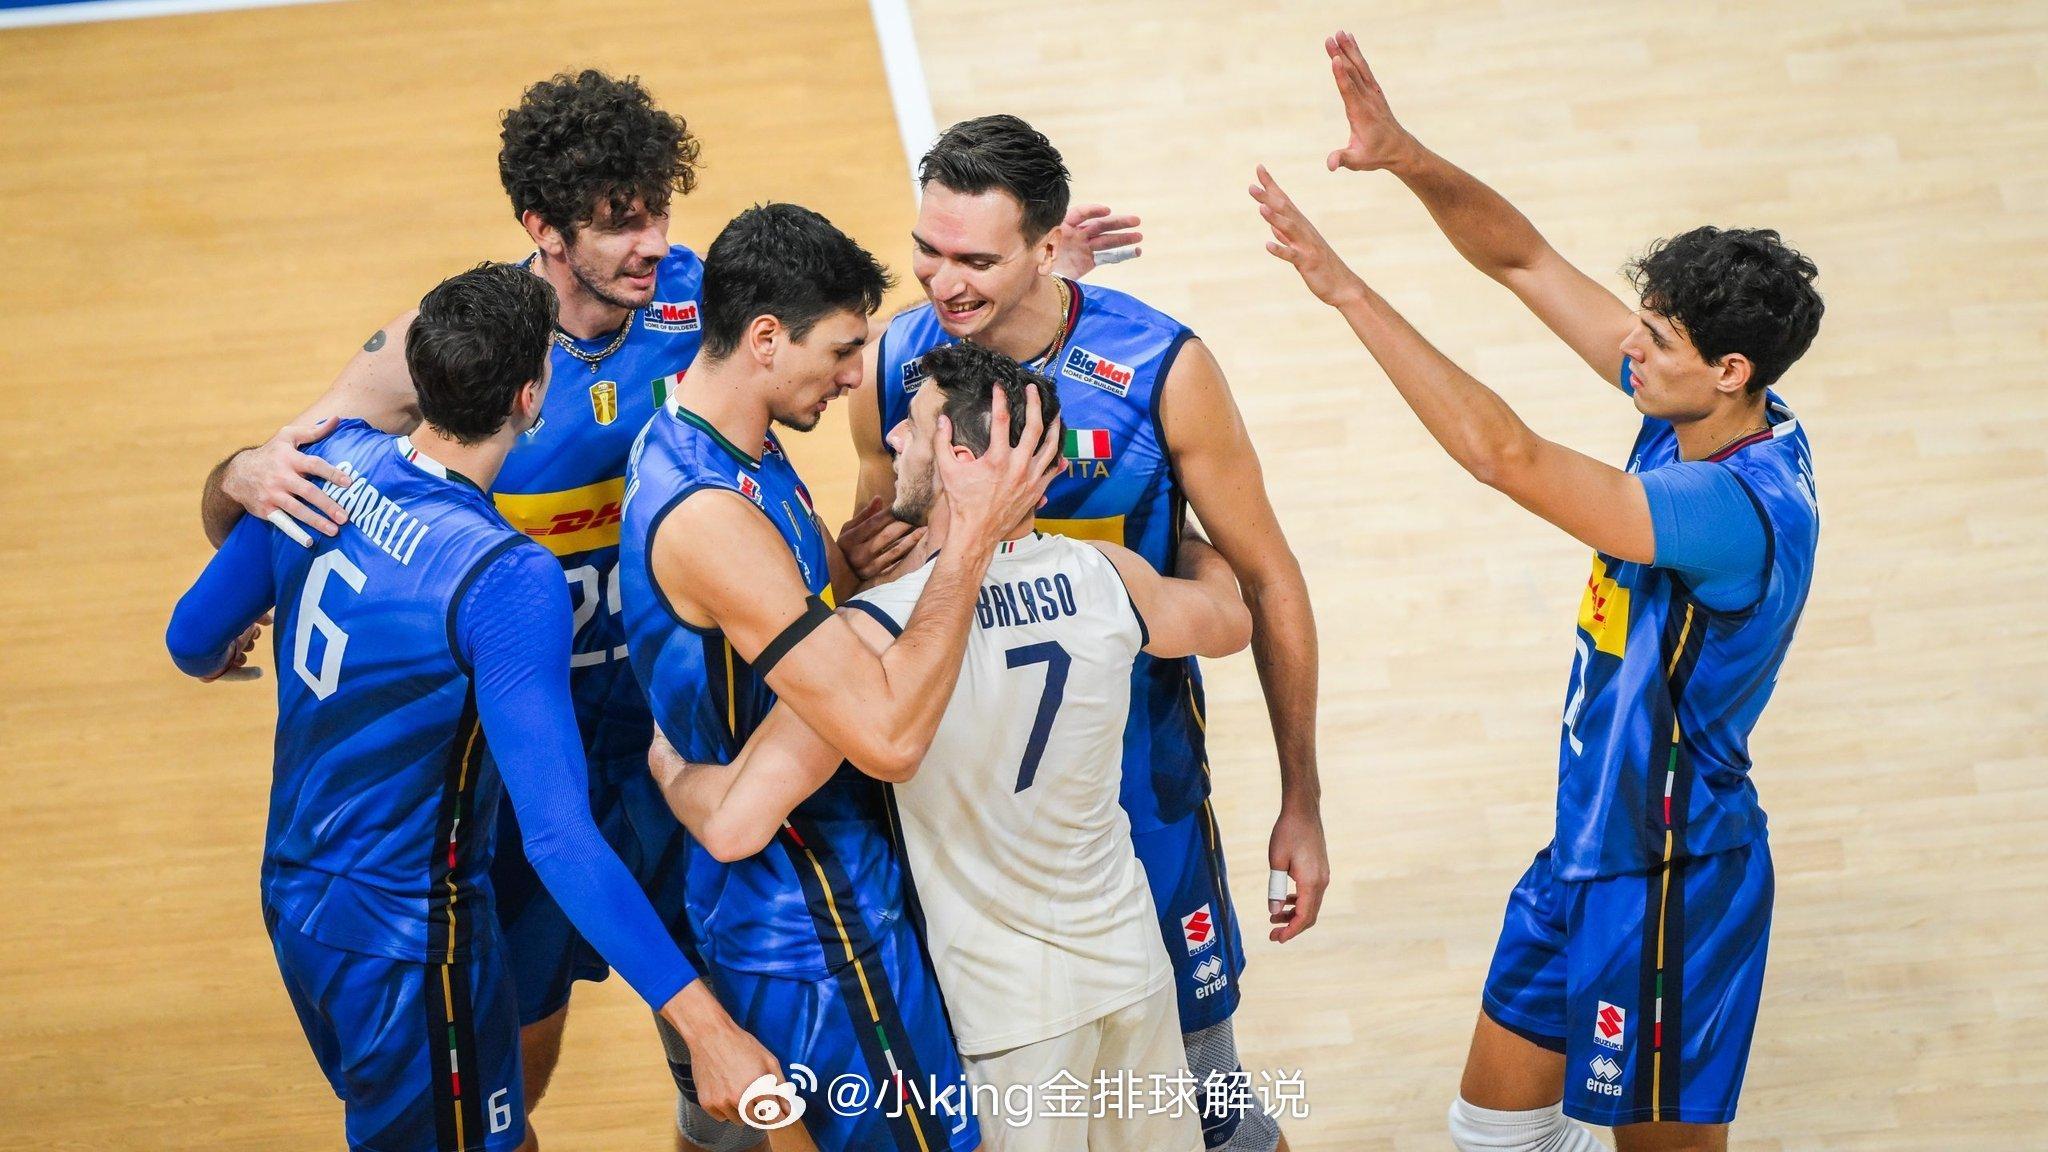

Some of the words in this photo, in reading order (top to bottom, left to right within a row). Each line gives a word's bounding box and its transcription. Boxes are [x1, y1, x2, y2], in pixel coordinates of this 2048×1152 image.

[668, 323, 698, 331] BUILDERS
[1063, 367, 1083, 380] HOME
[1083, 376, 1094, 384] OF
[1093, 380, 1124, 396] BUILDERS
[1068, 348, 1131, 386] BigMat
[547, 500, 621, 536] DH
[563, 563, 630, 668] 2
[974, 572, 1078, 630] BALASO
[293, 549, 368, 702] 6
[1005, 640, 1073, 795] 7
[1594, 1036, 1624, 1051] SUZUKI
[488, 1087, 512, 1134] 6
